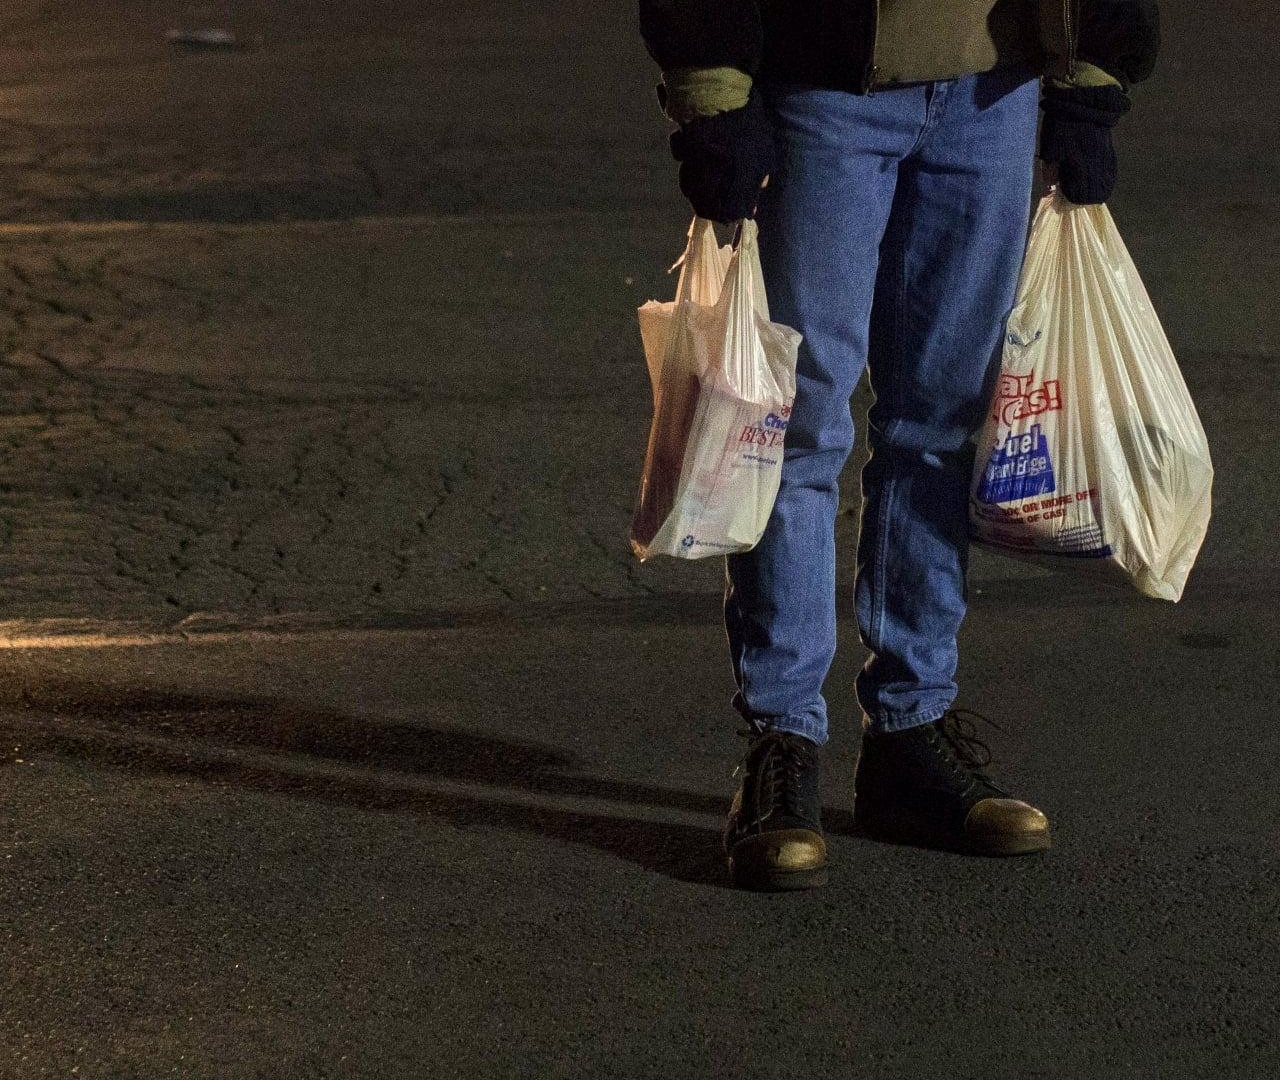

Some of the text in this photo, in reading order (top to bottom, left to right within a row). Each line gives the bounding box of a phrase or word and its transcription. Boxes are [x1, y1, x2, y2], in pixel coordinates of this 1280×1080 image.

[740, 426, 779, 447] BEST
[1023, 502, 1038, 513] OR
[1041, 495, 1073, 510] MORE
[1027, 514, 1041, 523] OF
